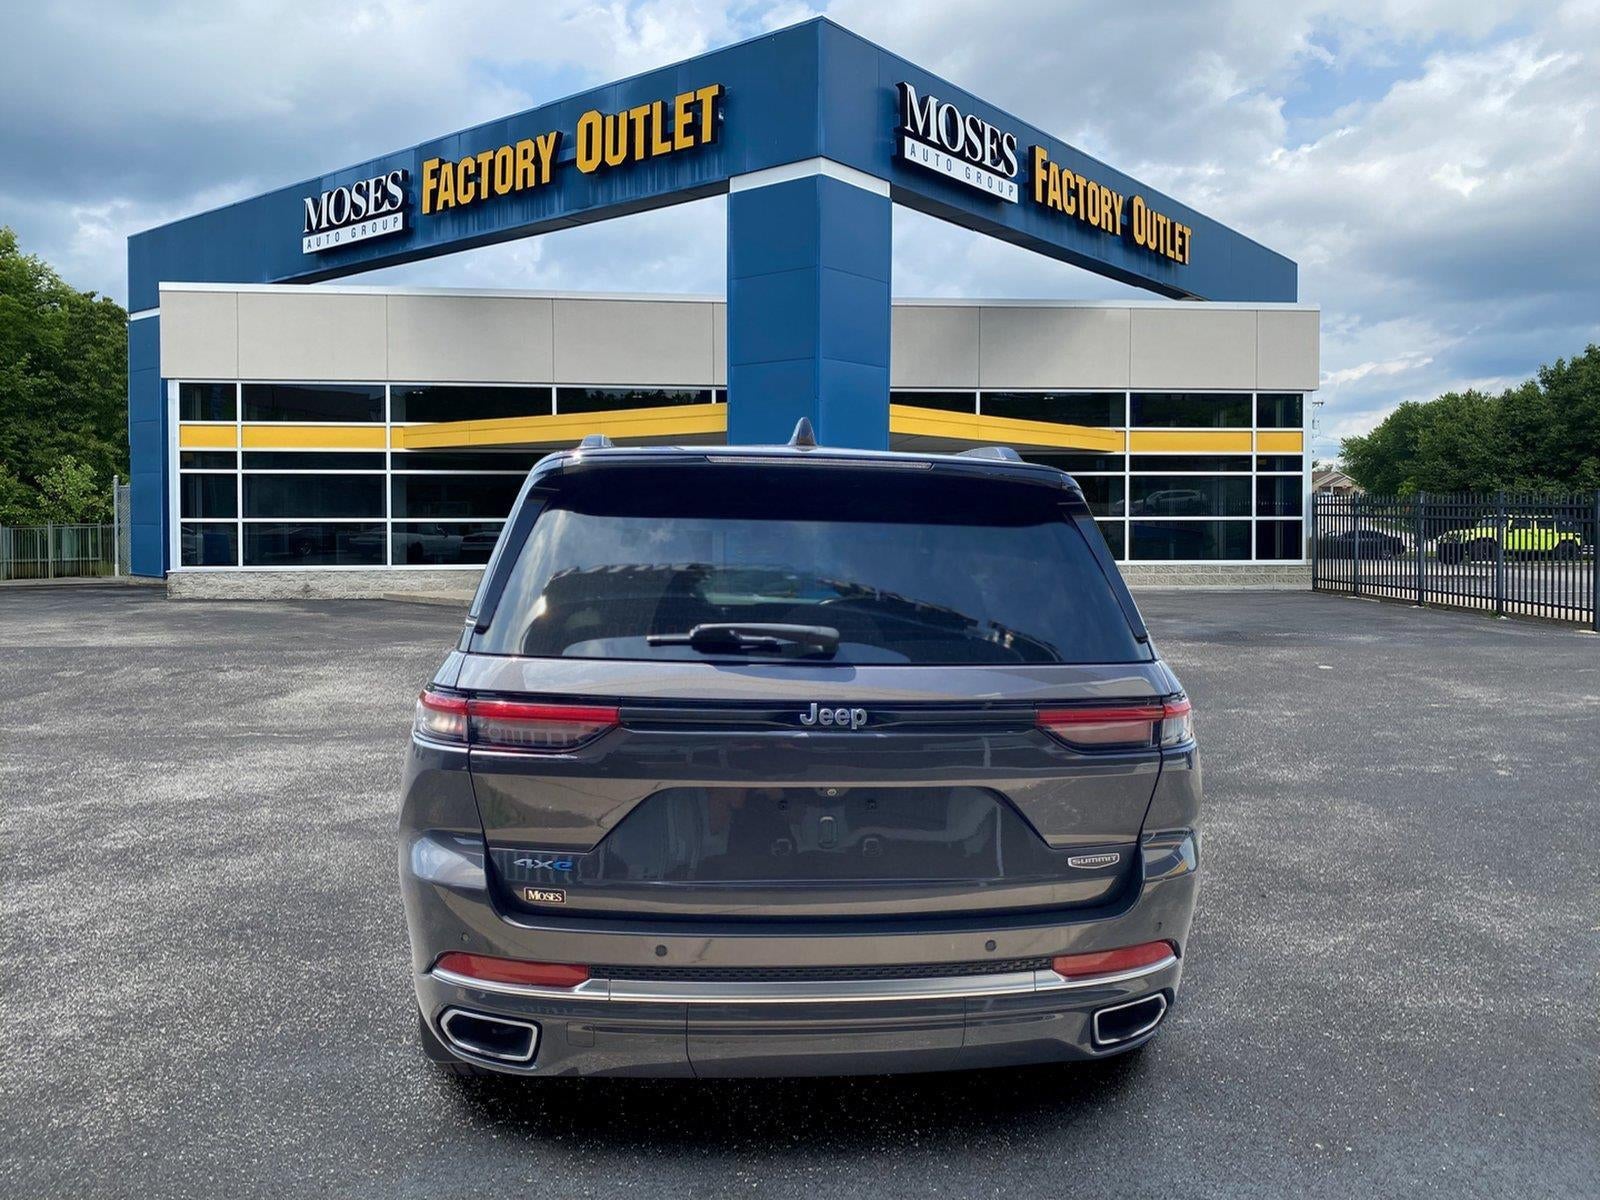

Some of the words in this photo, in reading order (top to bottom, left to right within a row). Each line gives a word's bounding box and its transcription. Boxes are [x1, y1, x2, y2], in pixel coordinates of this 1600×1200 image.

[422, 131, 558, 214] FACTORY
[575, 84, 719, 174] OUTLET
[901, 82, 1018, 178] MOSES
[909, 143, 953, 172] AUTO
[965, 166, 1015, 197] GROUP
[302, 170, 405, 232] MOSES
[1034, 144, 1124, 235] FACTORY
[1132, 195, 1192, 265] OUTLET
[306, 230, 341, 249] AUTO
[350, 216, 401, 238] GROUP
[799, 702, 868, 730] Jeep
[527, 889, 563, 902] MOSES
